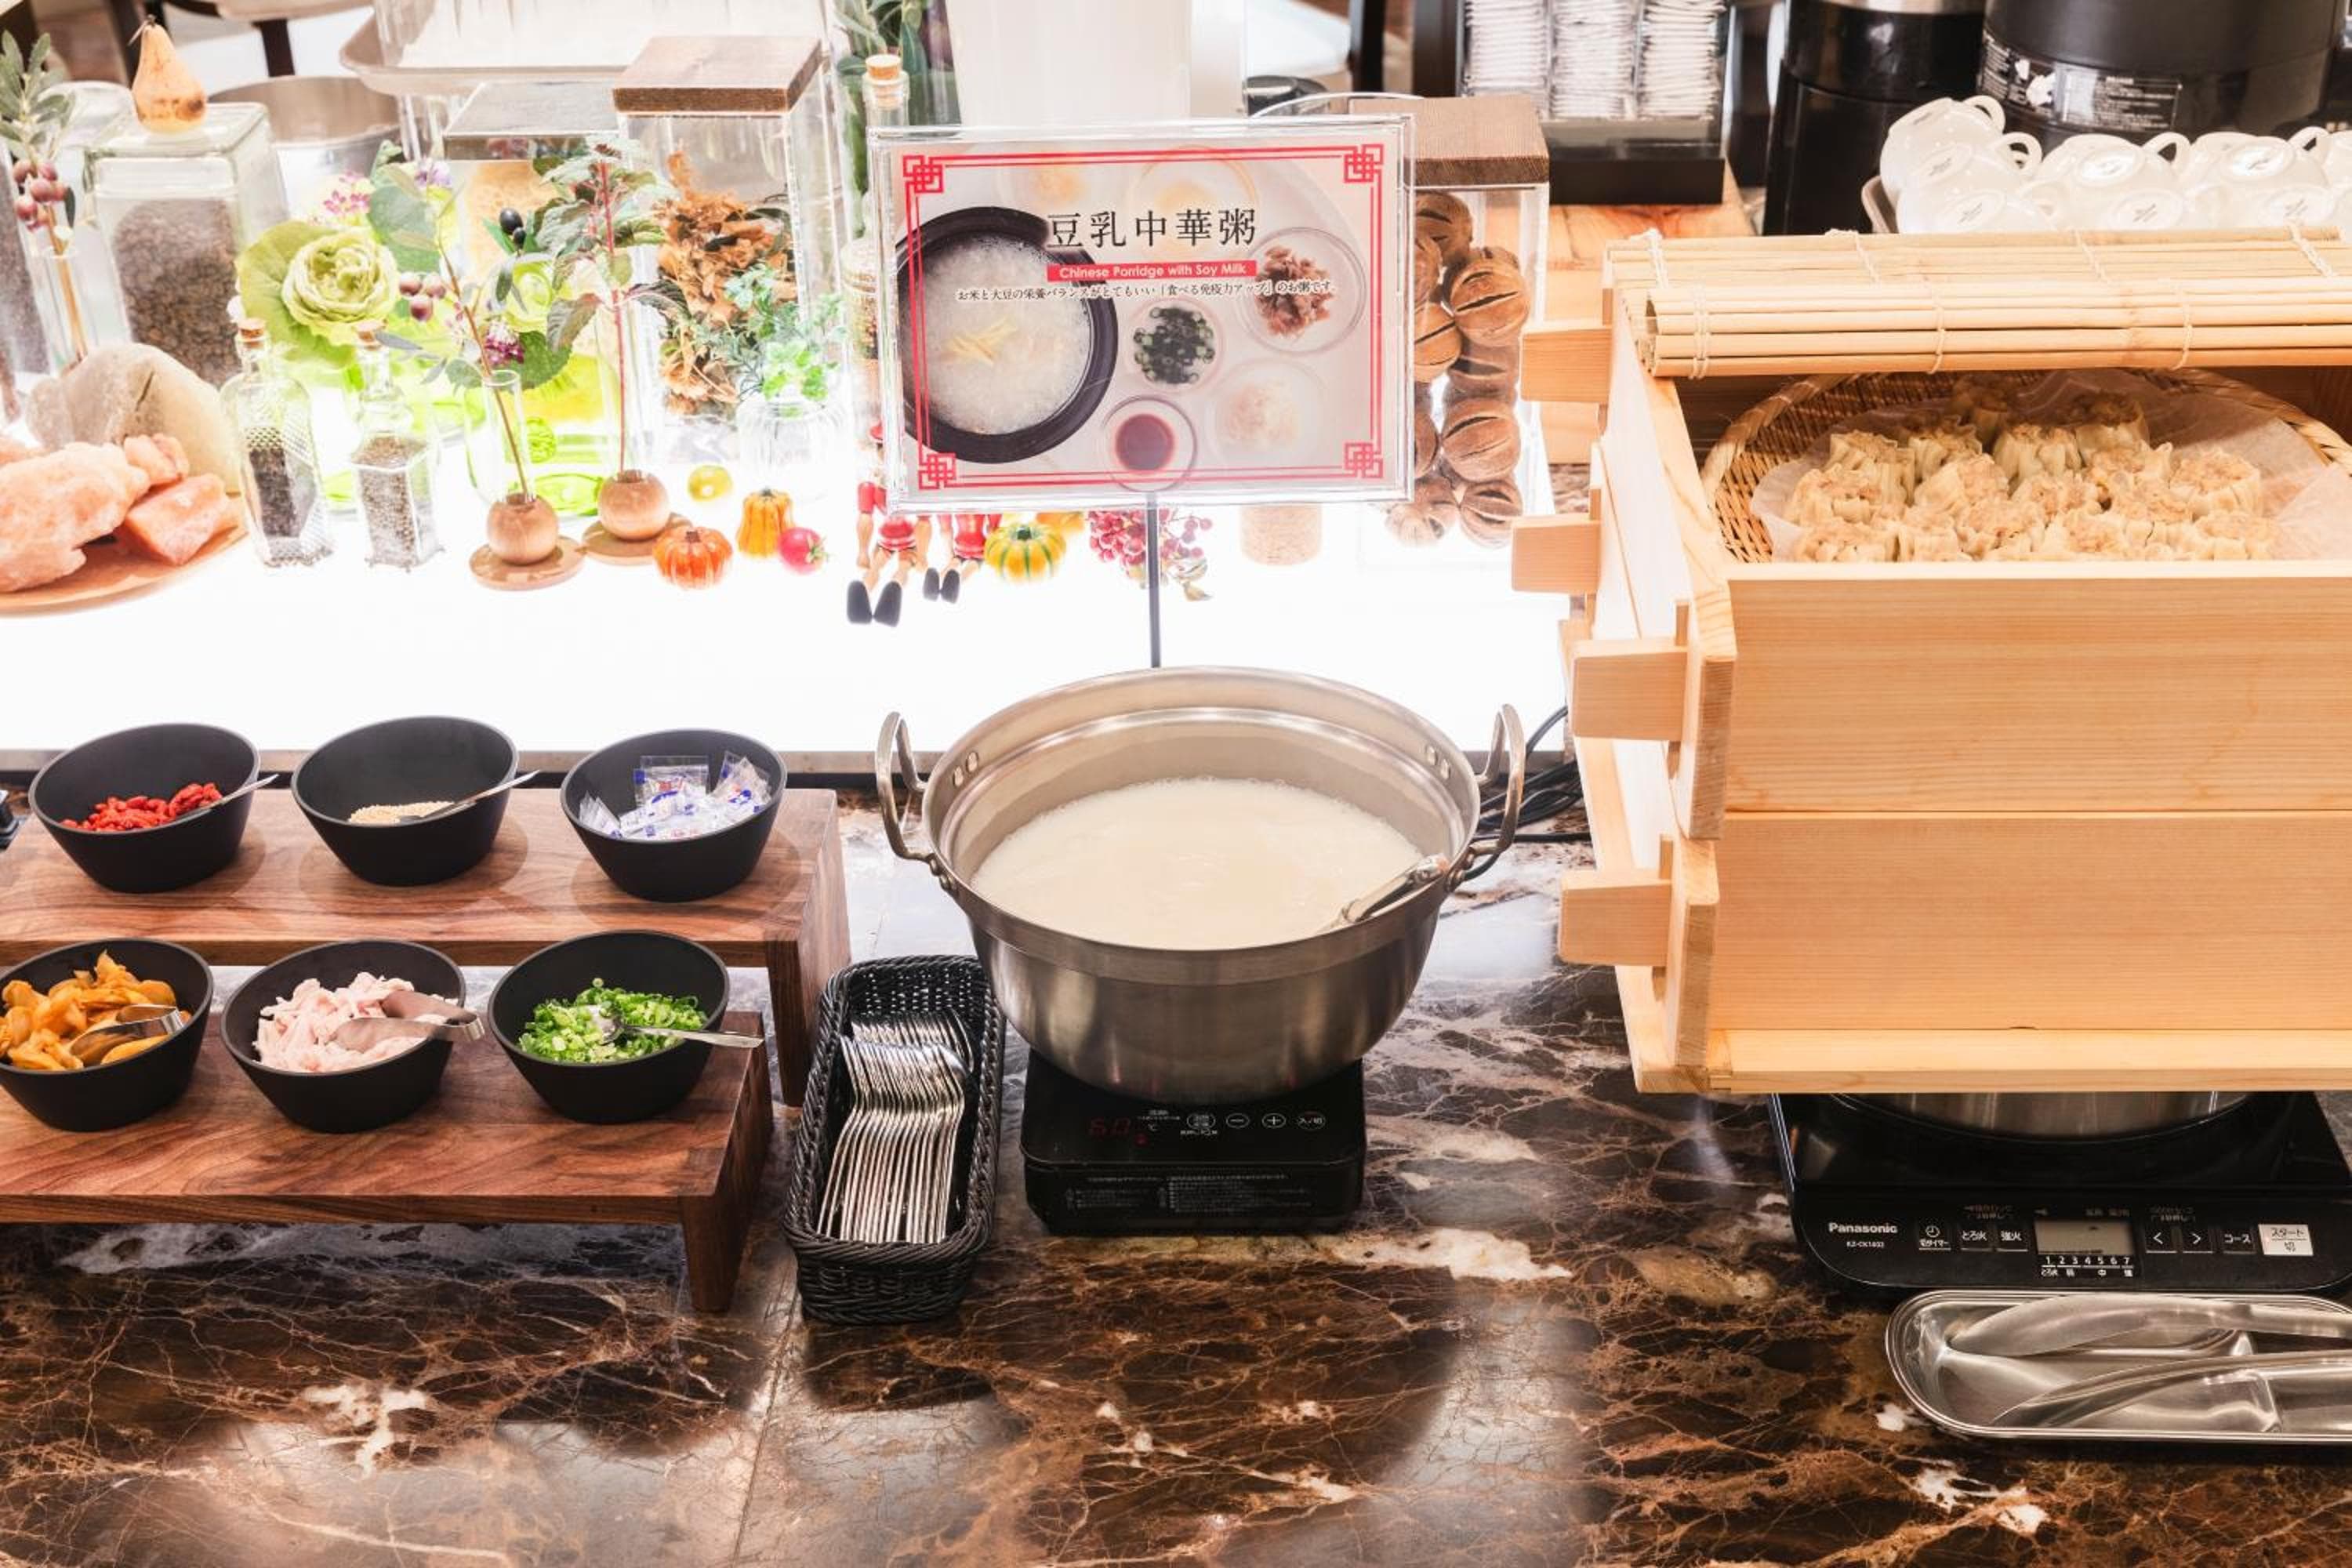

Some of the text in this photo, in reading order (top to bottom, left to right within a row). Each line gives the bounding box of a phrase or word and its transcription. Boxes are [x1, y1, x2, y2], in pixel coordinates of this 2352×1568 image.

[1047, 208, 1256, 249] 豆乳中華粥
[1059, 260, 1246, 278] Chinese Porridge with Soy Milk
[1828, 1221, 1898, 1233] Panasonic
[2270, 1227, 2305, 1237] スタート
[2224, 1233, 2251, 1243] コース
[2045, 1255, 2130, 1265] 1 2 3 4 5 6 7
